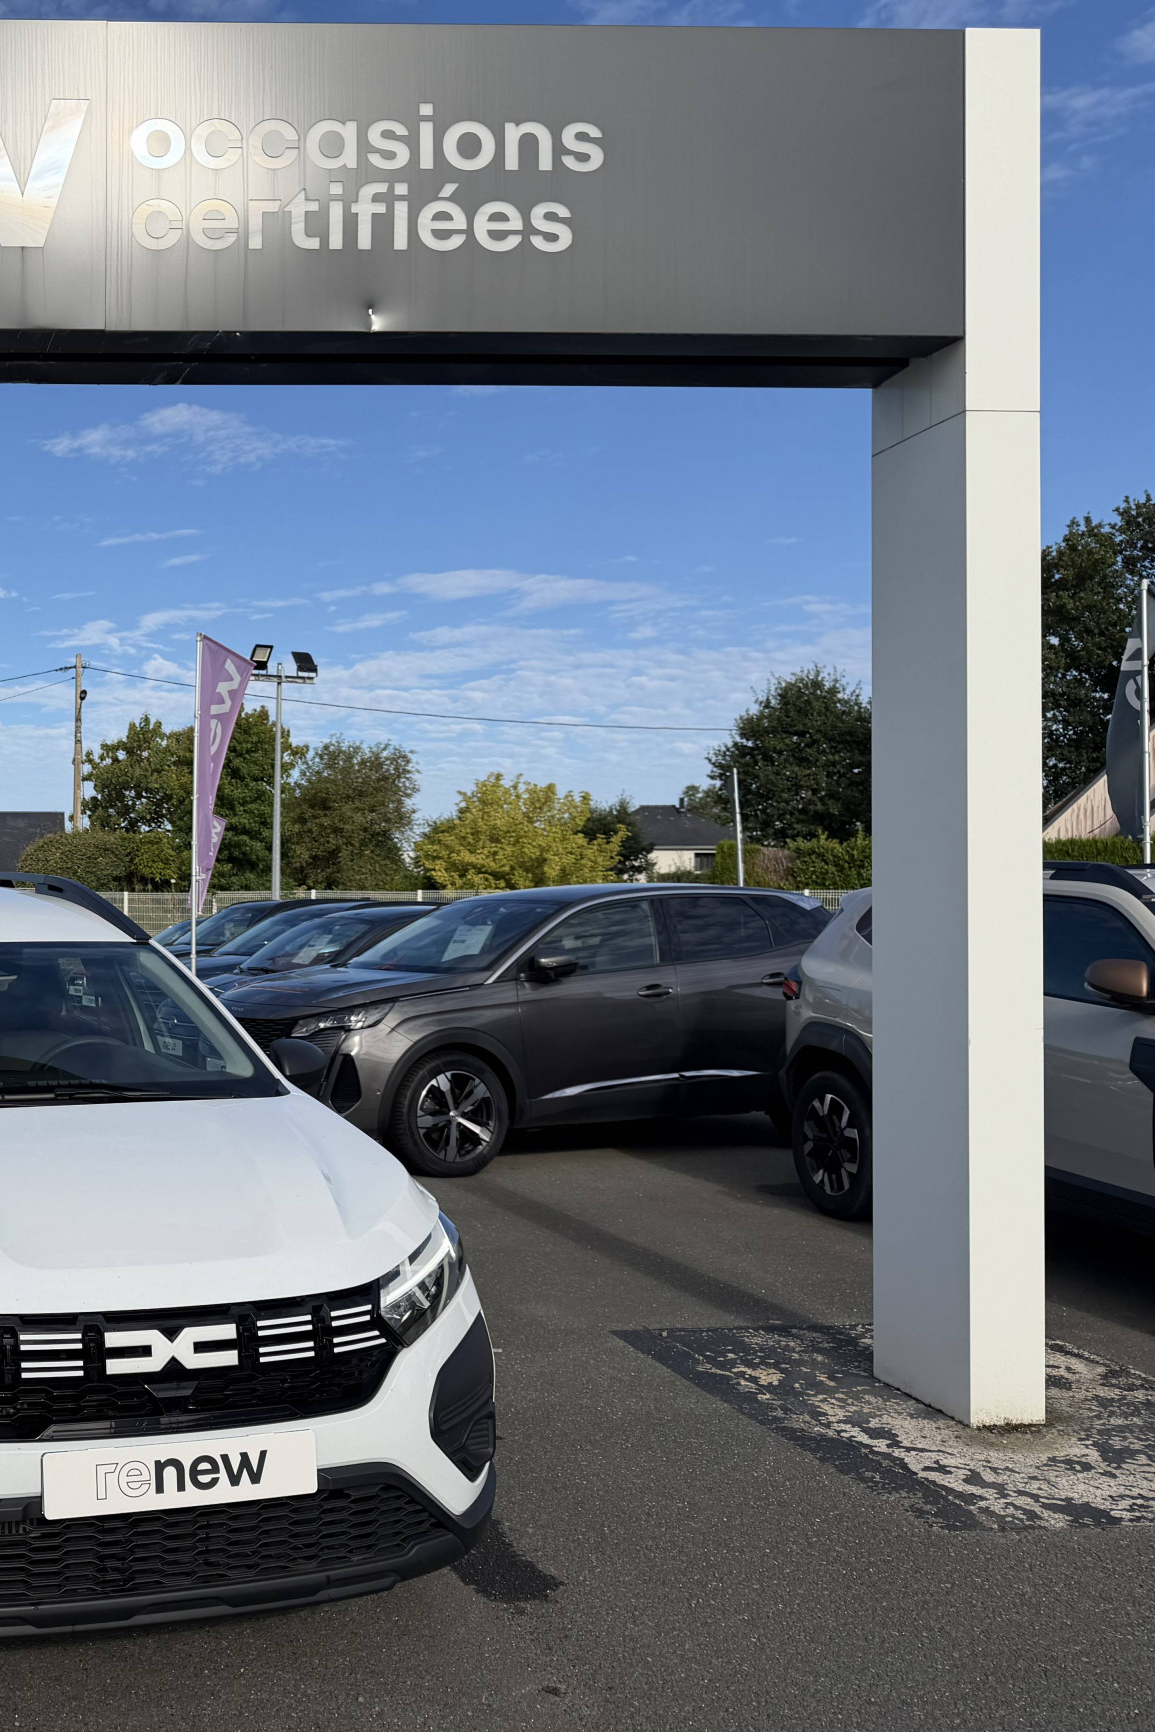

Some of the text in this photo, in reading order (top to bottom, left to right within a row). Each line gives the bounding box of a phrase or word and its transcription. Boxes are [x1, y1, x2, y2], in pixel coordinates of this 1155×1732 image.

[129, 101, 605, 173] occasions
[131, 180, 574, 252] certifiées
[95, 1449, 268, 1501] renew
